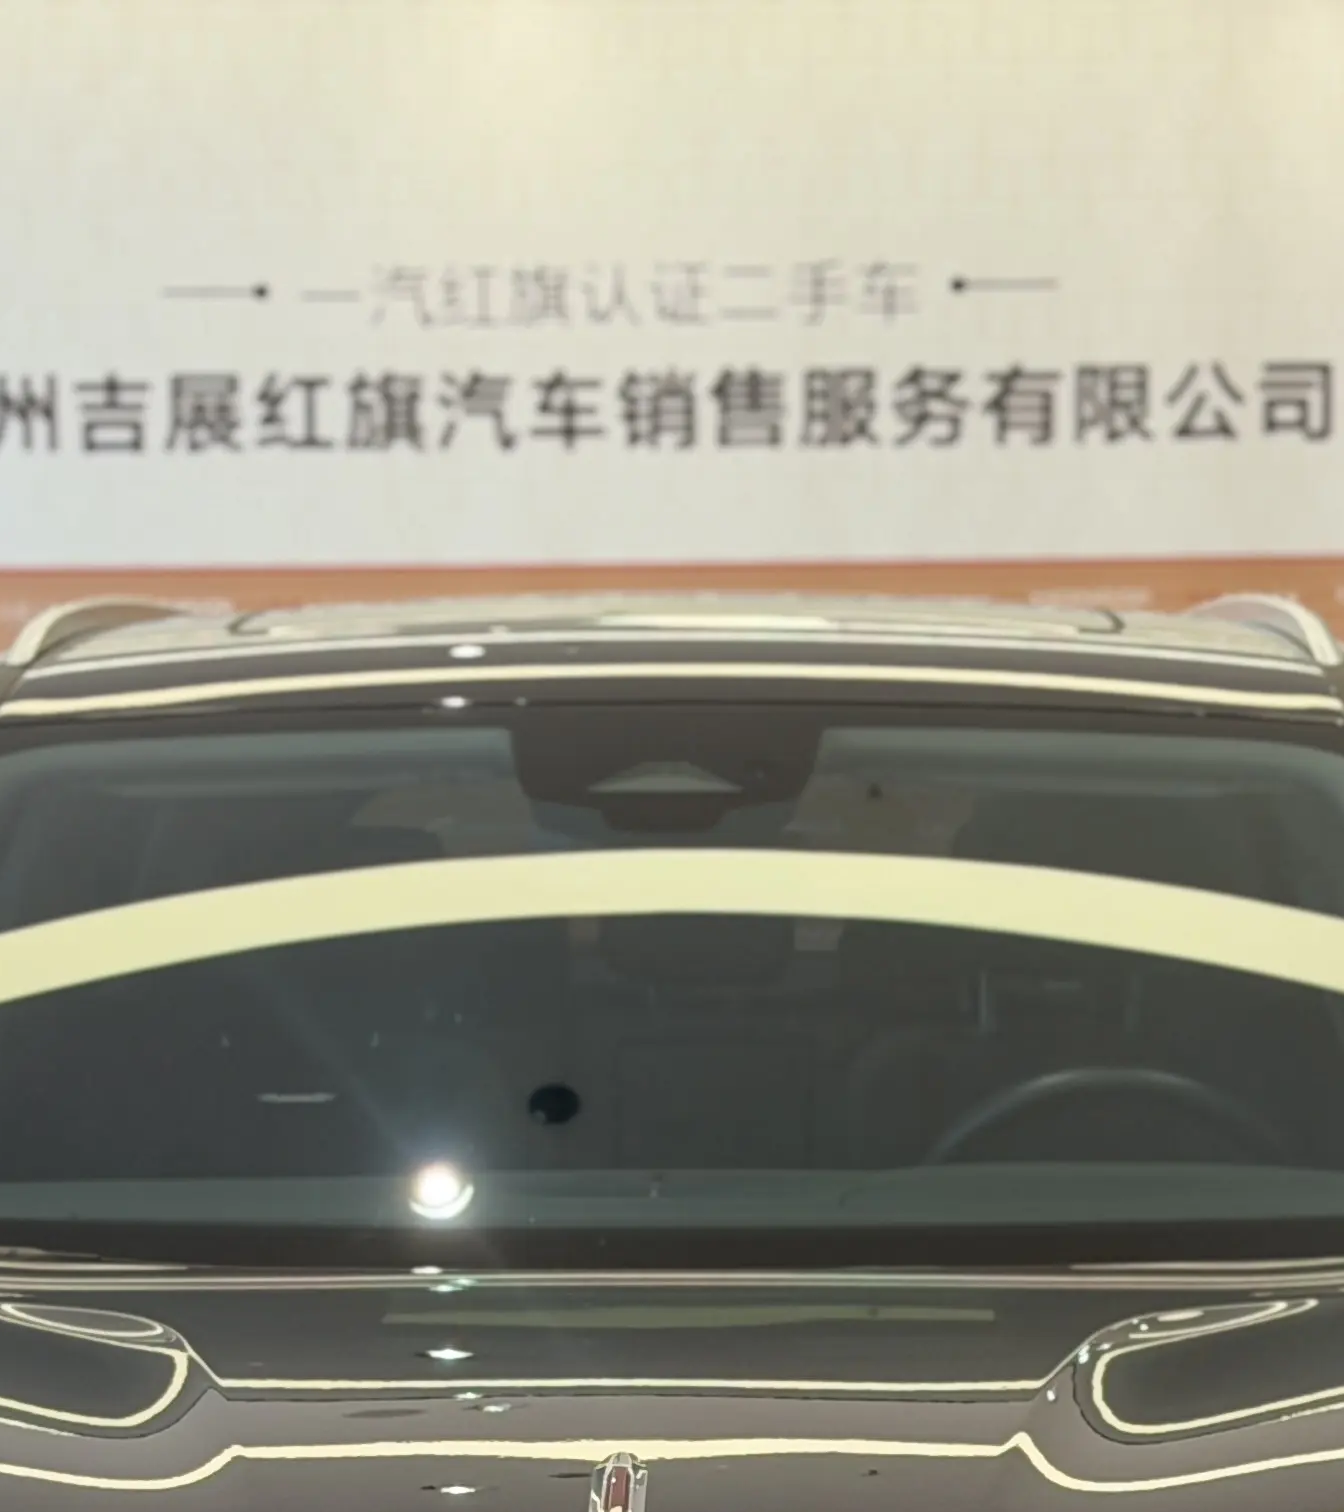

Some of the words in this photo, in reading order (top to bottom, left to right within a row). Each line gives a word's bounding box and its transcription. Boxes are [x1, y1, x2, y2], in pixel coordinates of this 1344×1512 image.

[300, 258, 920, 328] 一汽红旗认证二手车
